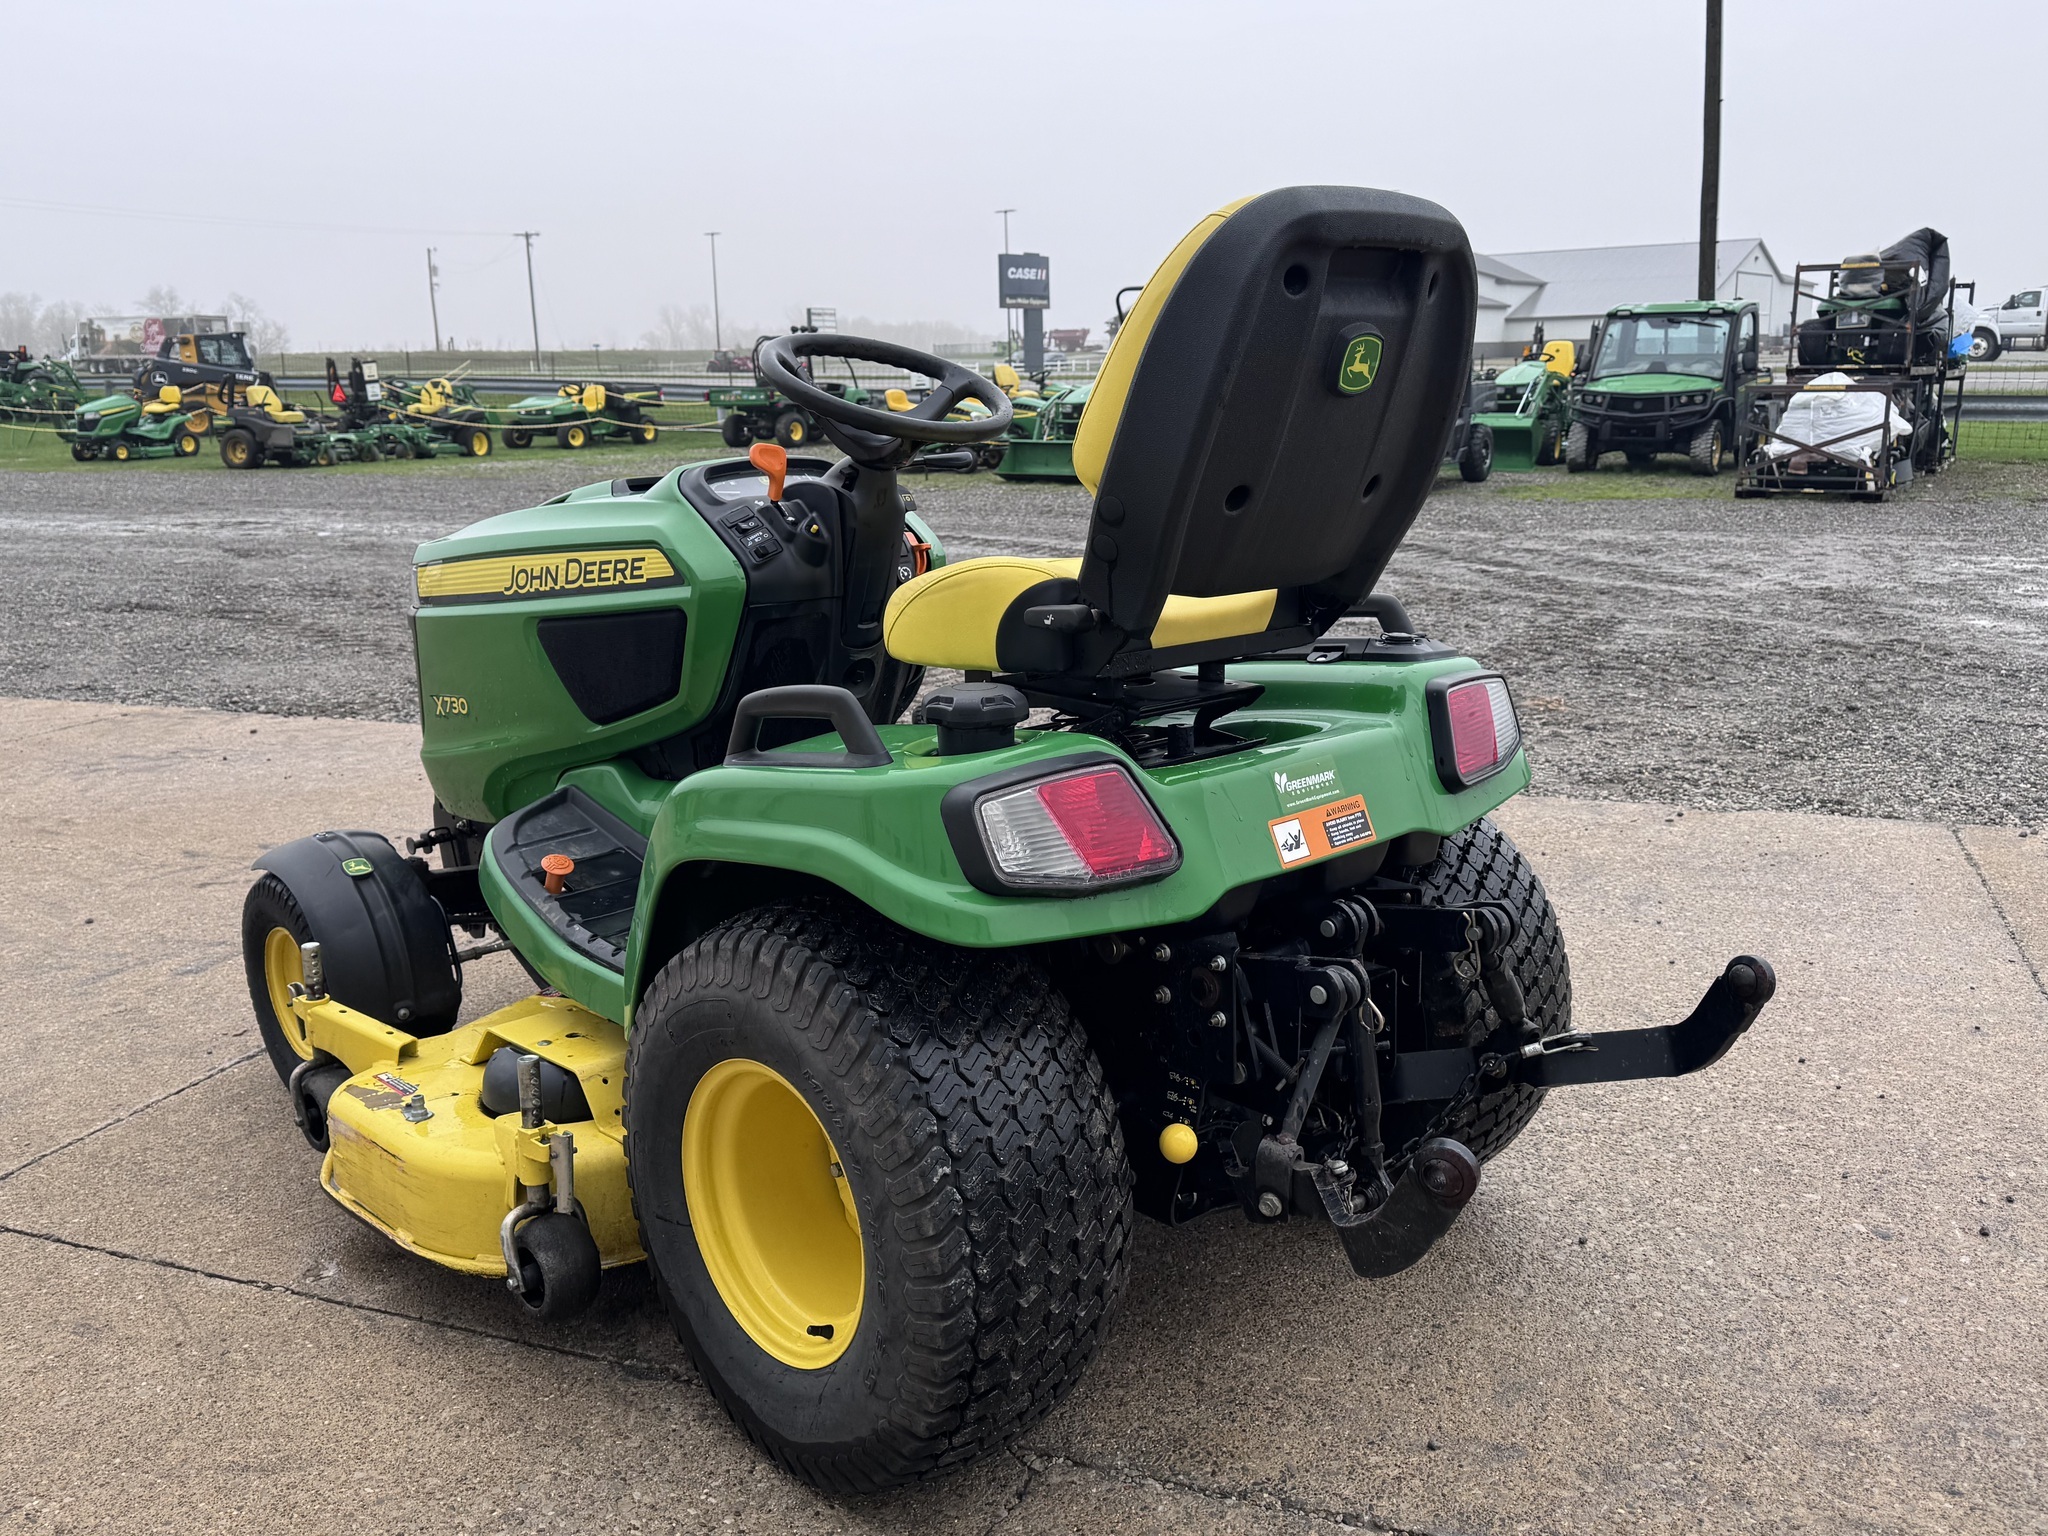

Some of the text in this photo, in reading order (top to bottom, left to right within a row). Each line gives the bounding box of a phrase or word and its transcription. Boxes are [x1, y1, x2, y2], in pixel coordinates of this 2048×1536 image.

[1008, 266, 1037, 280] CASE
[503, 557, 647, 594] JOHN DEERE
[432, 695, 468, 716] X730
[1286, 770, 1335, 792] GREENMARK
[1332, 801, 1360, 815] WARNING
